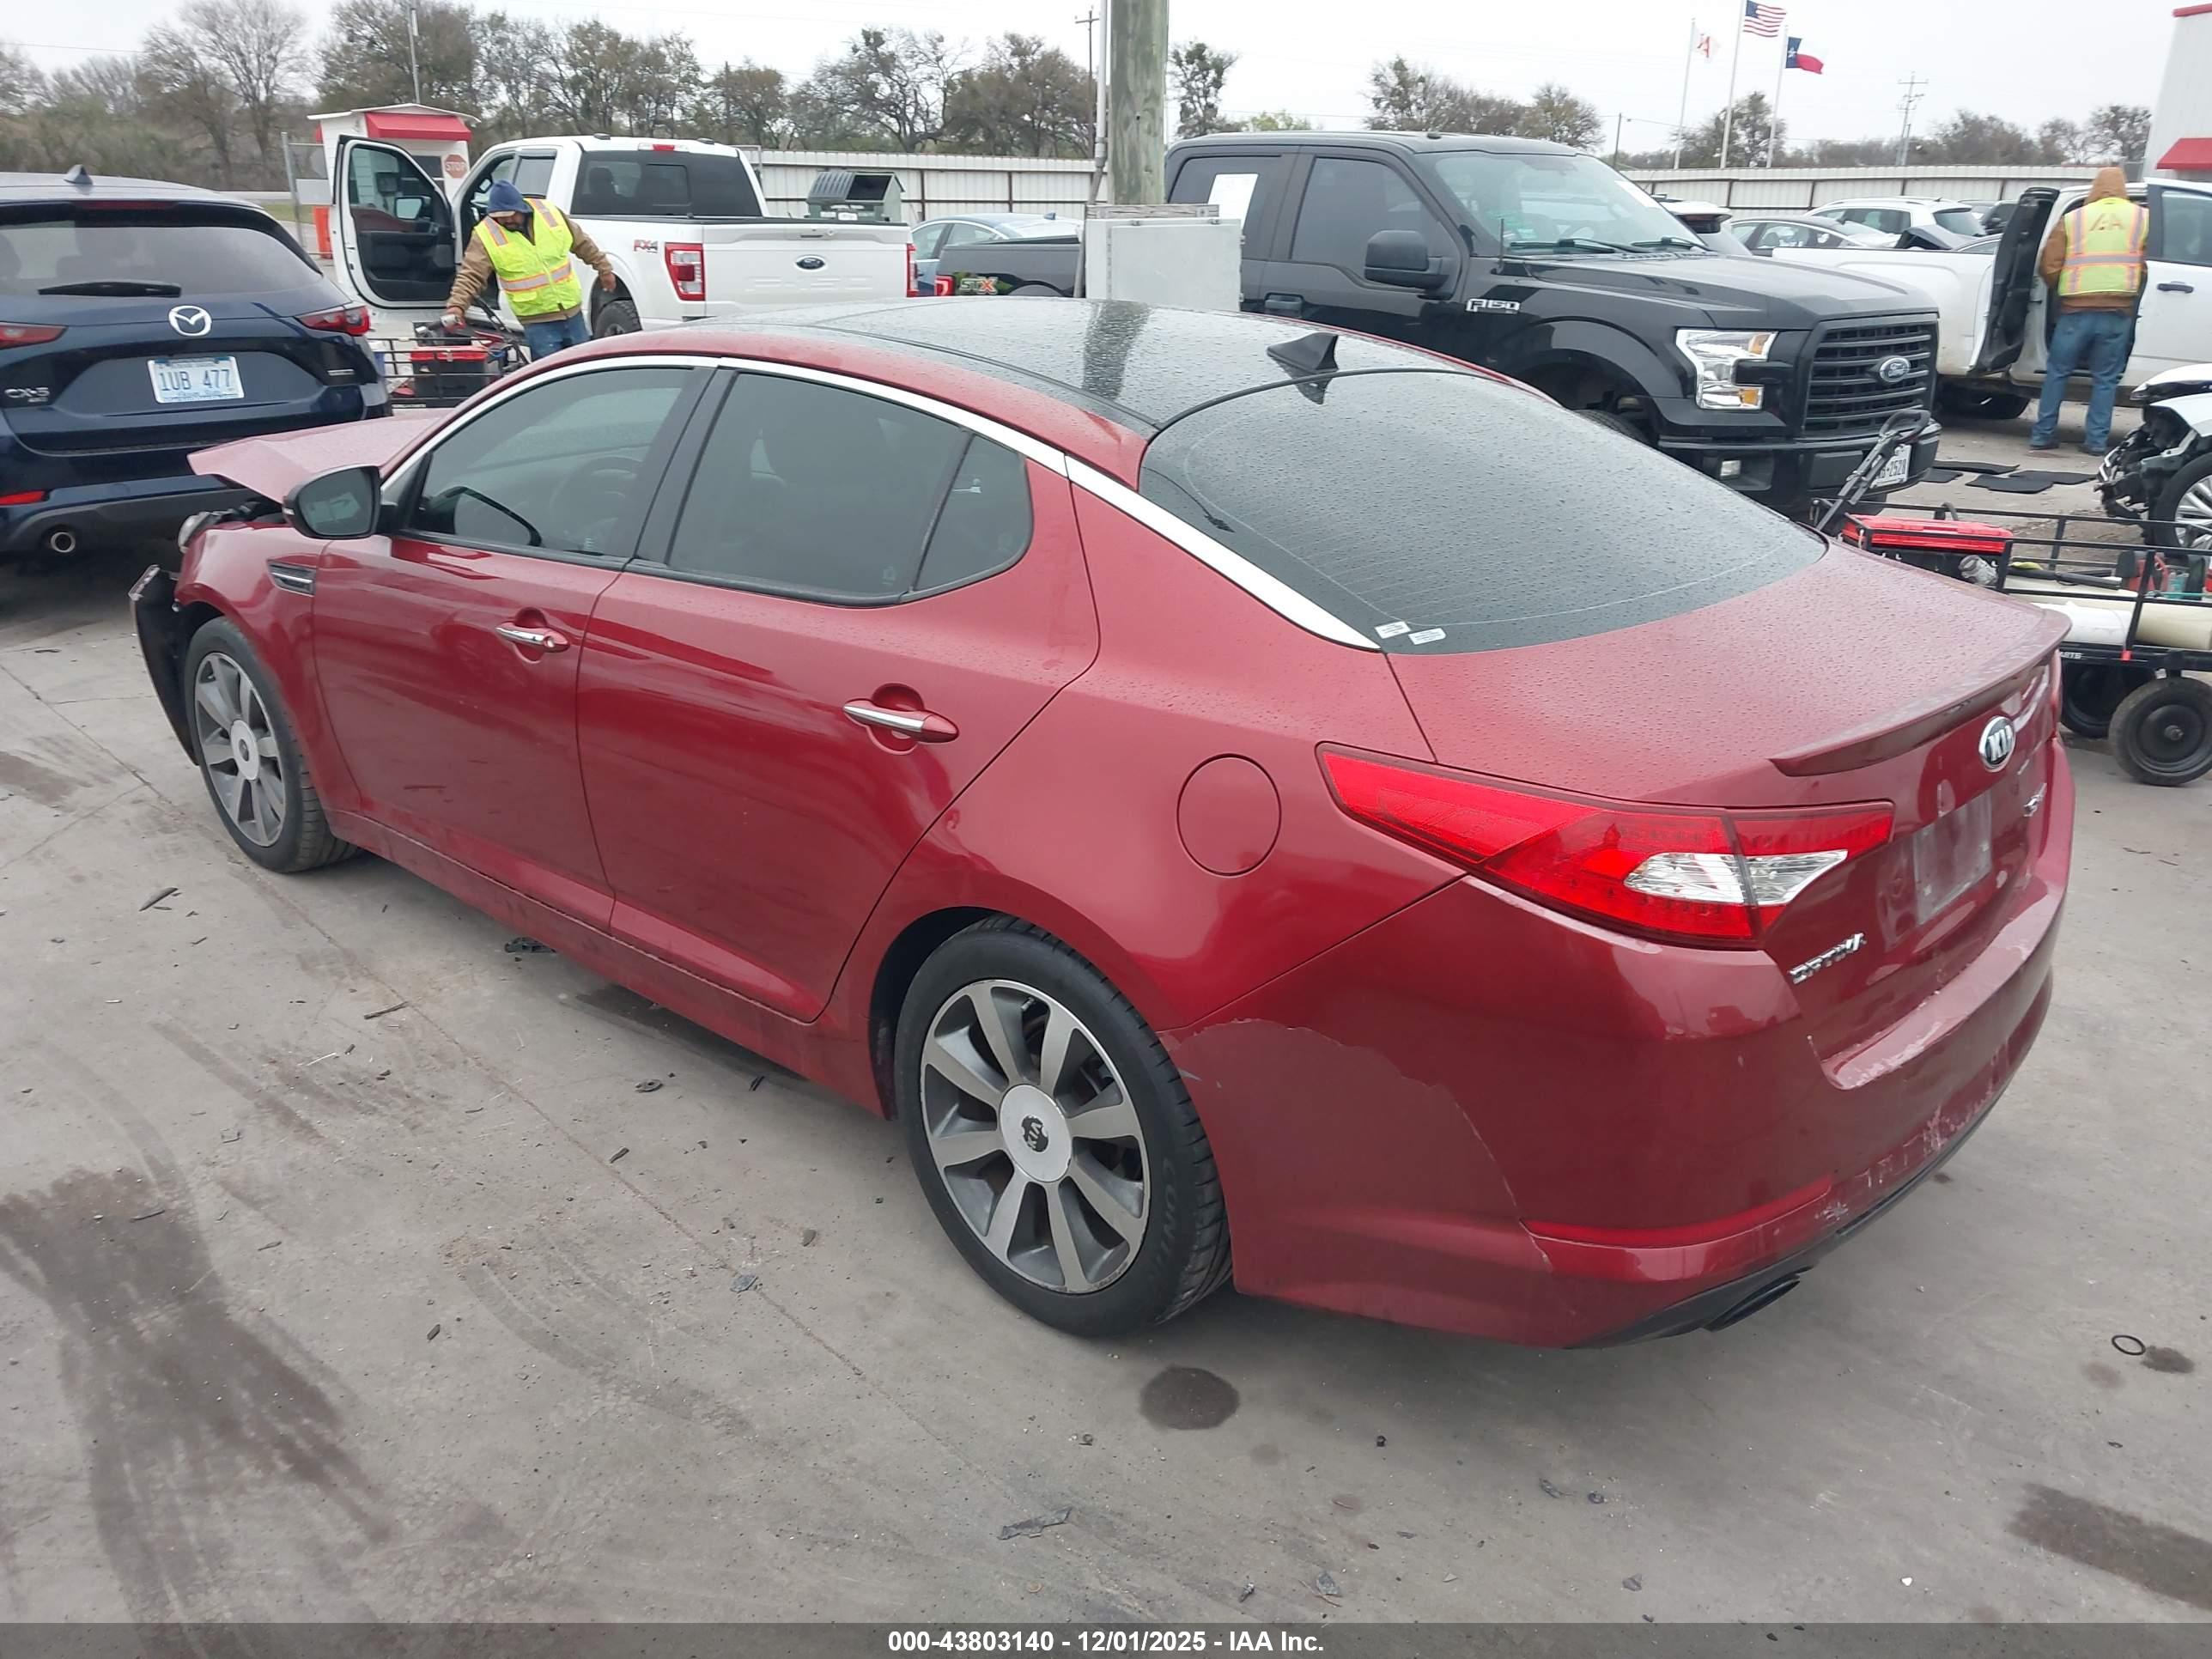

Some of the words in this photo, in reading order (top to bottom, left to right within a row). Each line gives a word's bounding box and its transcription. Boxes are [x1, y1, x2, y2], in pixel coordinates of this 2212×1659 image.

[445, 163, 466, 173] STOP
[633, 240, 659, 252] FX4
[959, 276, 998, 295] STX
[159, 371, 191, 392] 1UB
[203, 368, 230, 389] 477
